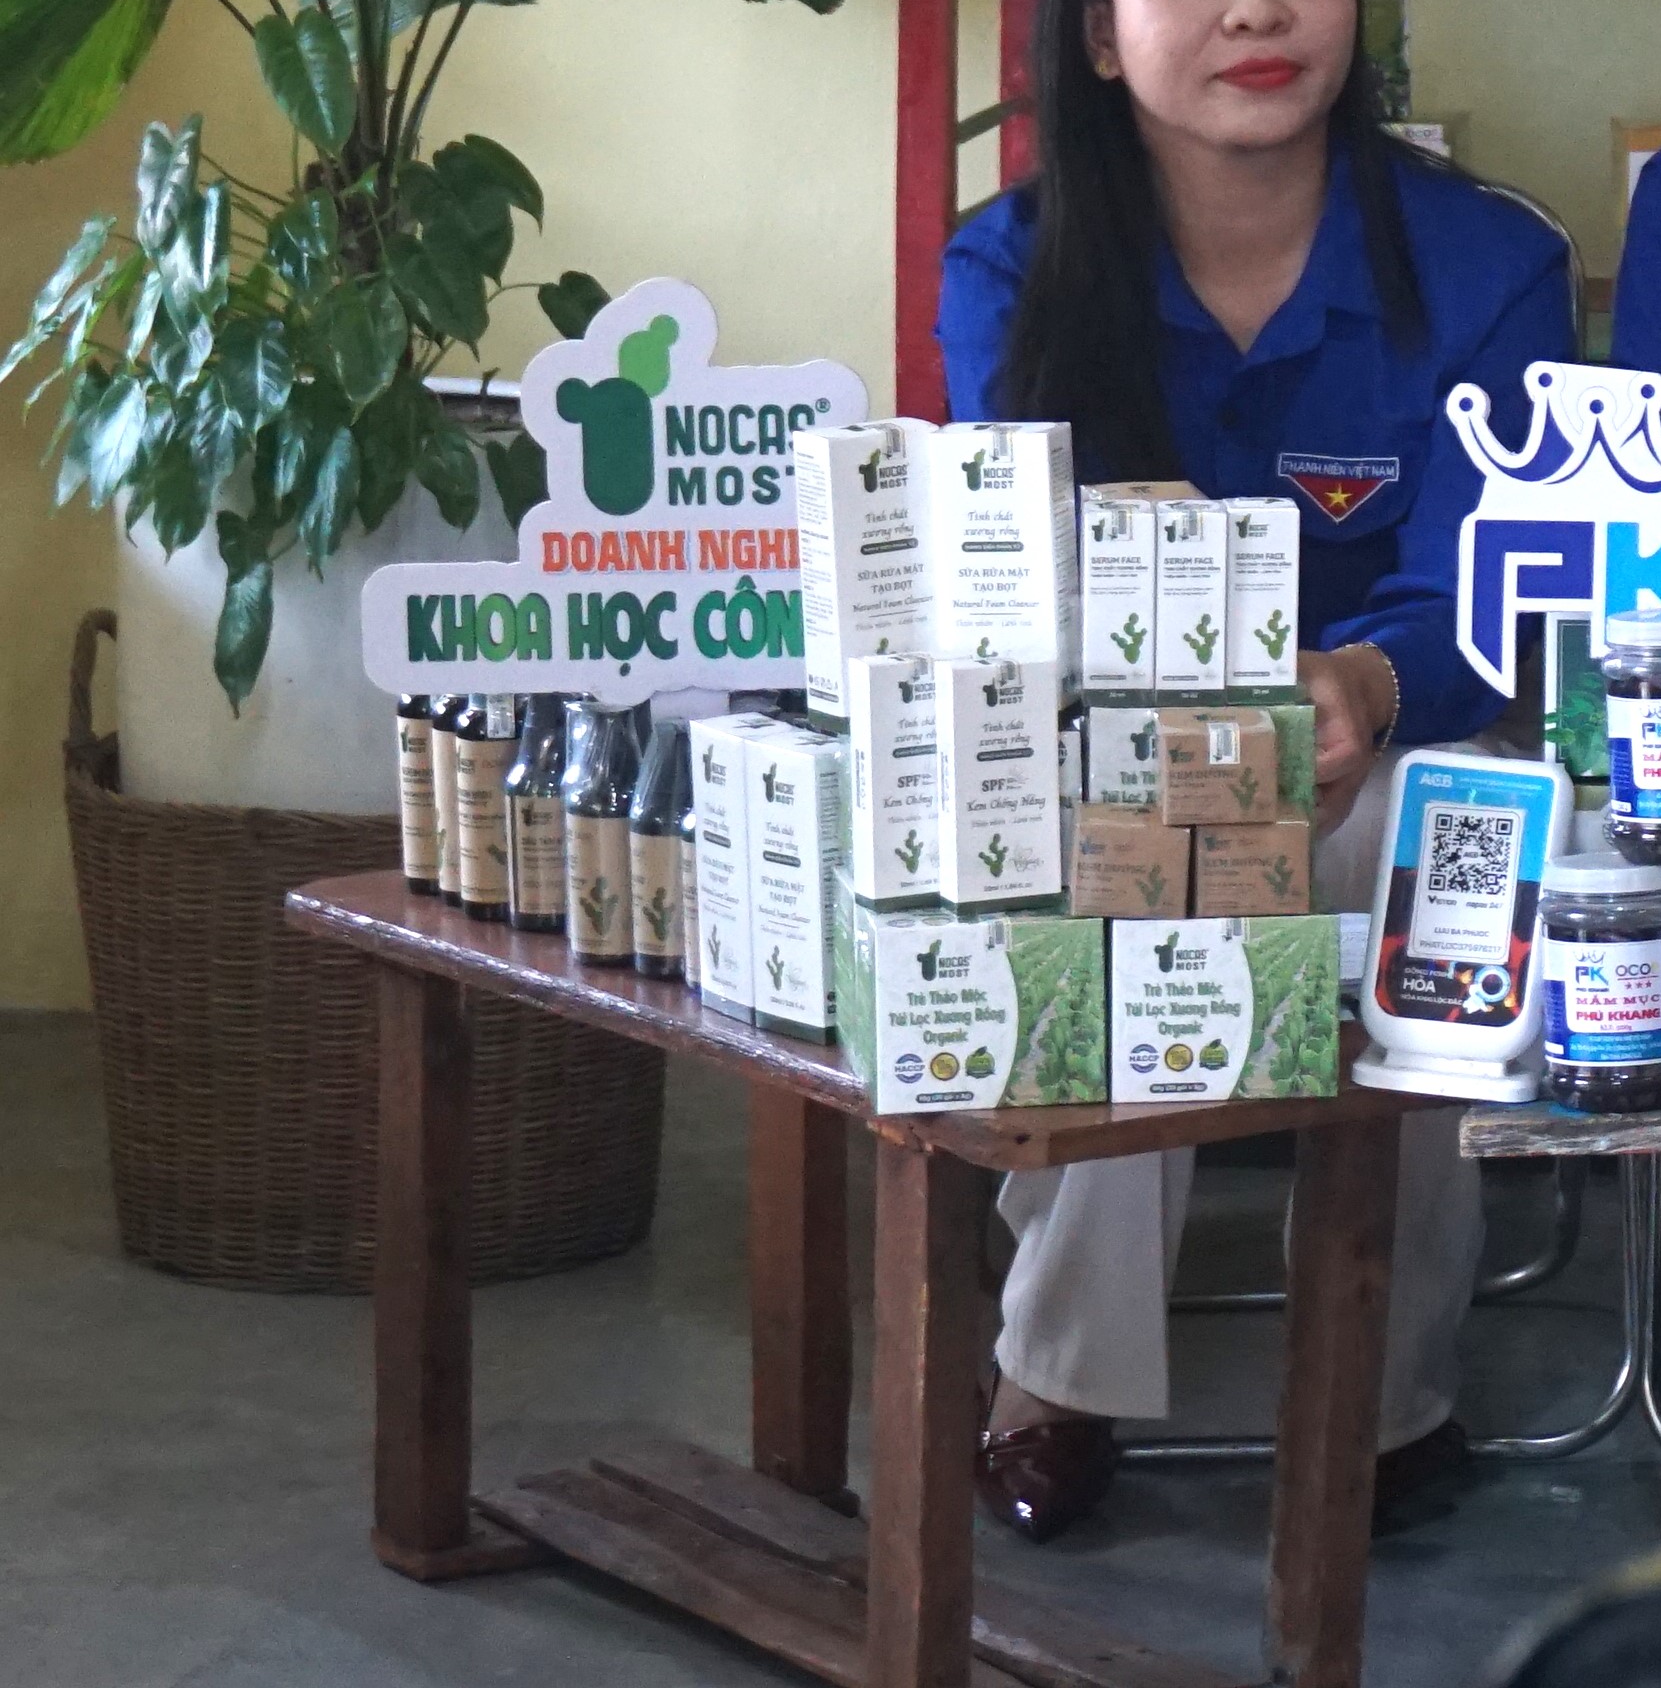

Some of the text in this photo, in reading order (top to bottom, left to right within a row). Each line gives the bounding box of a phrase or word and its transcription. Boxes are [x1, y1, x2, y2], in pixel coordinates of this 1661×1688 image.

[667, 465, 795, 506] MOS
[542, 530, 799, 572] DOANH NGHI
[406, 575, 805, 677] KHOA HỌC CÔN
[981, 779, 1005, 792] SPF
[1419, 774, 1453, 788] ACB
